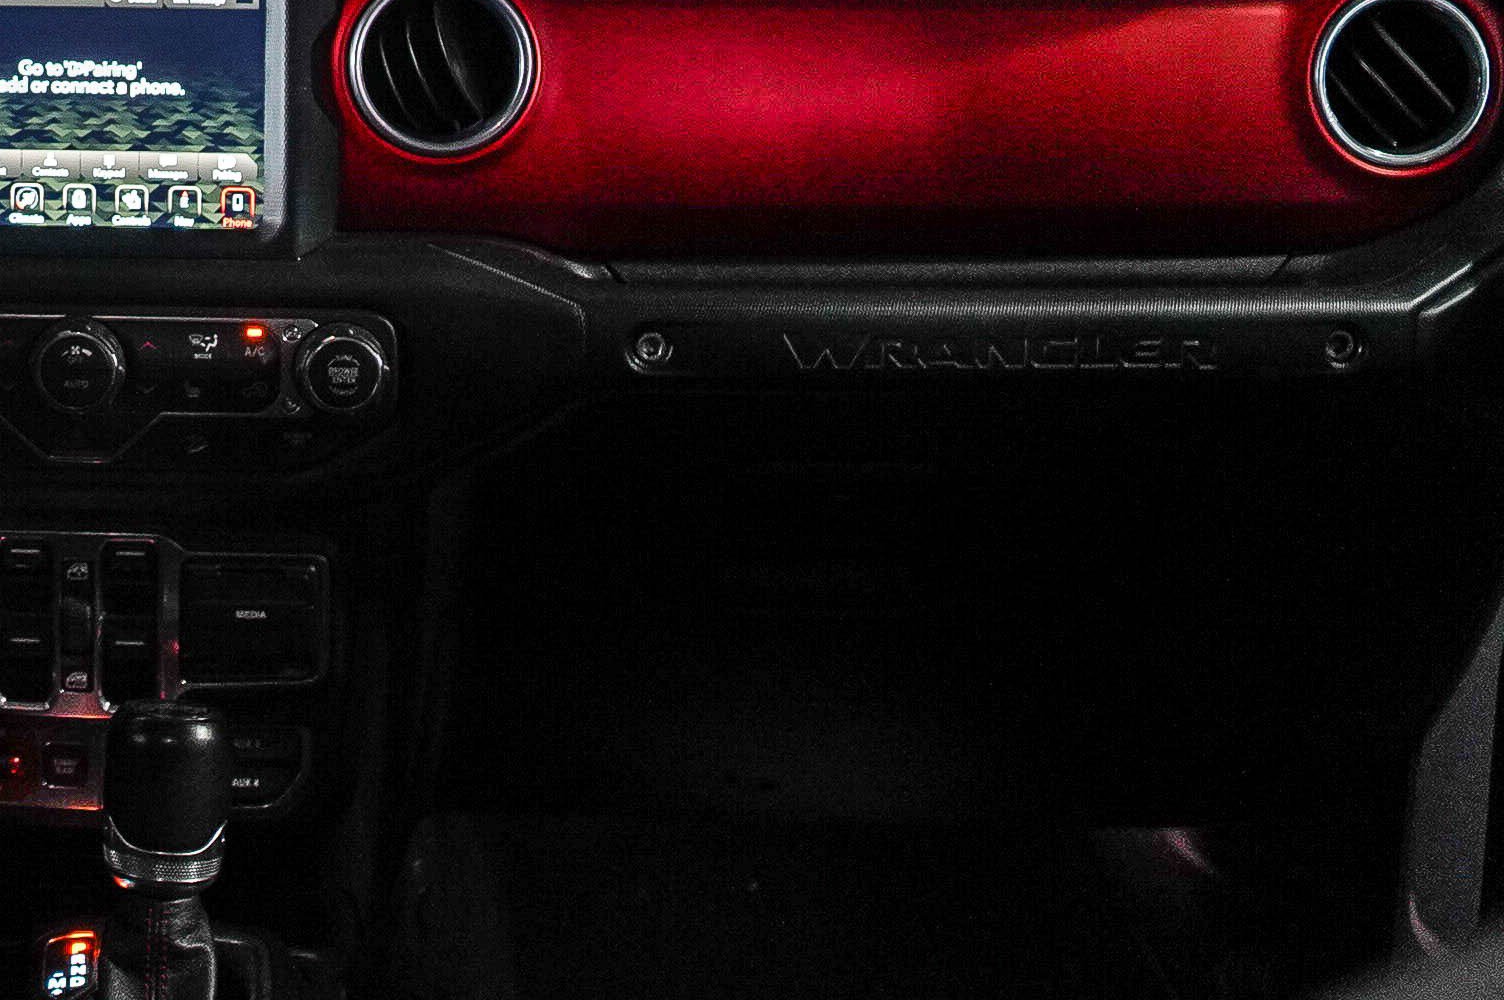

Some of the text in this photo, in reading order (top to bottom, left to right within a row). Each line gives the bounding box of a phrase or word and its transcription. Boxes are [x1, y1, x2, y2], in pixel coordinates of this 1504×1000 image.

[17, 58, 44, 77] Go
[45, 60, 64, 77] to
[30, 79, 49, 93] or
[50, 79, 115, 95] connect
[116, 81, 127, 95] a
[129, 77, 186, 99] phone.
[222, 217, 254, 229] Phone
[244, 346, 266, 357] A/C
[782, 332, 1218, 371] WRANGLER
[235, 609, 268, 619] MEDIA
[47, 977, 67, 990] M
